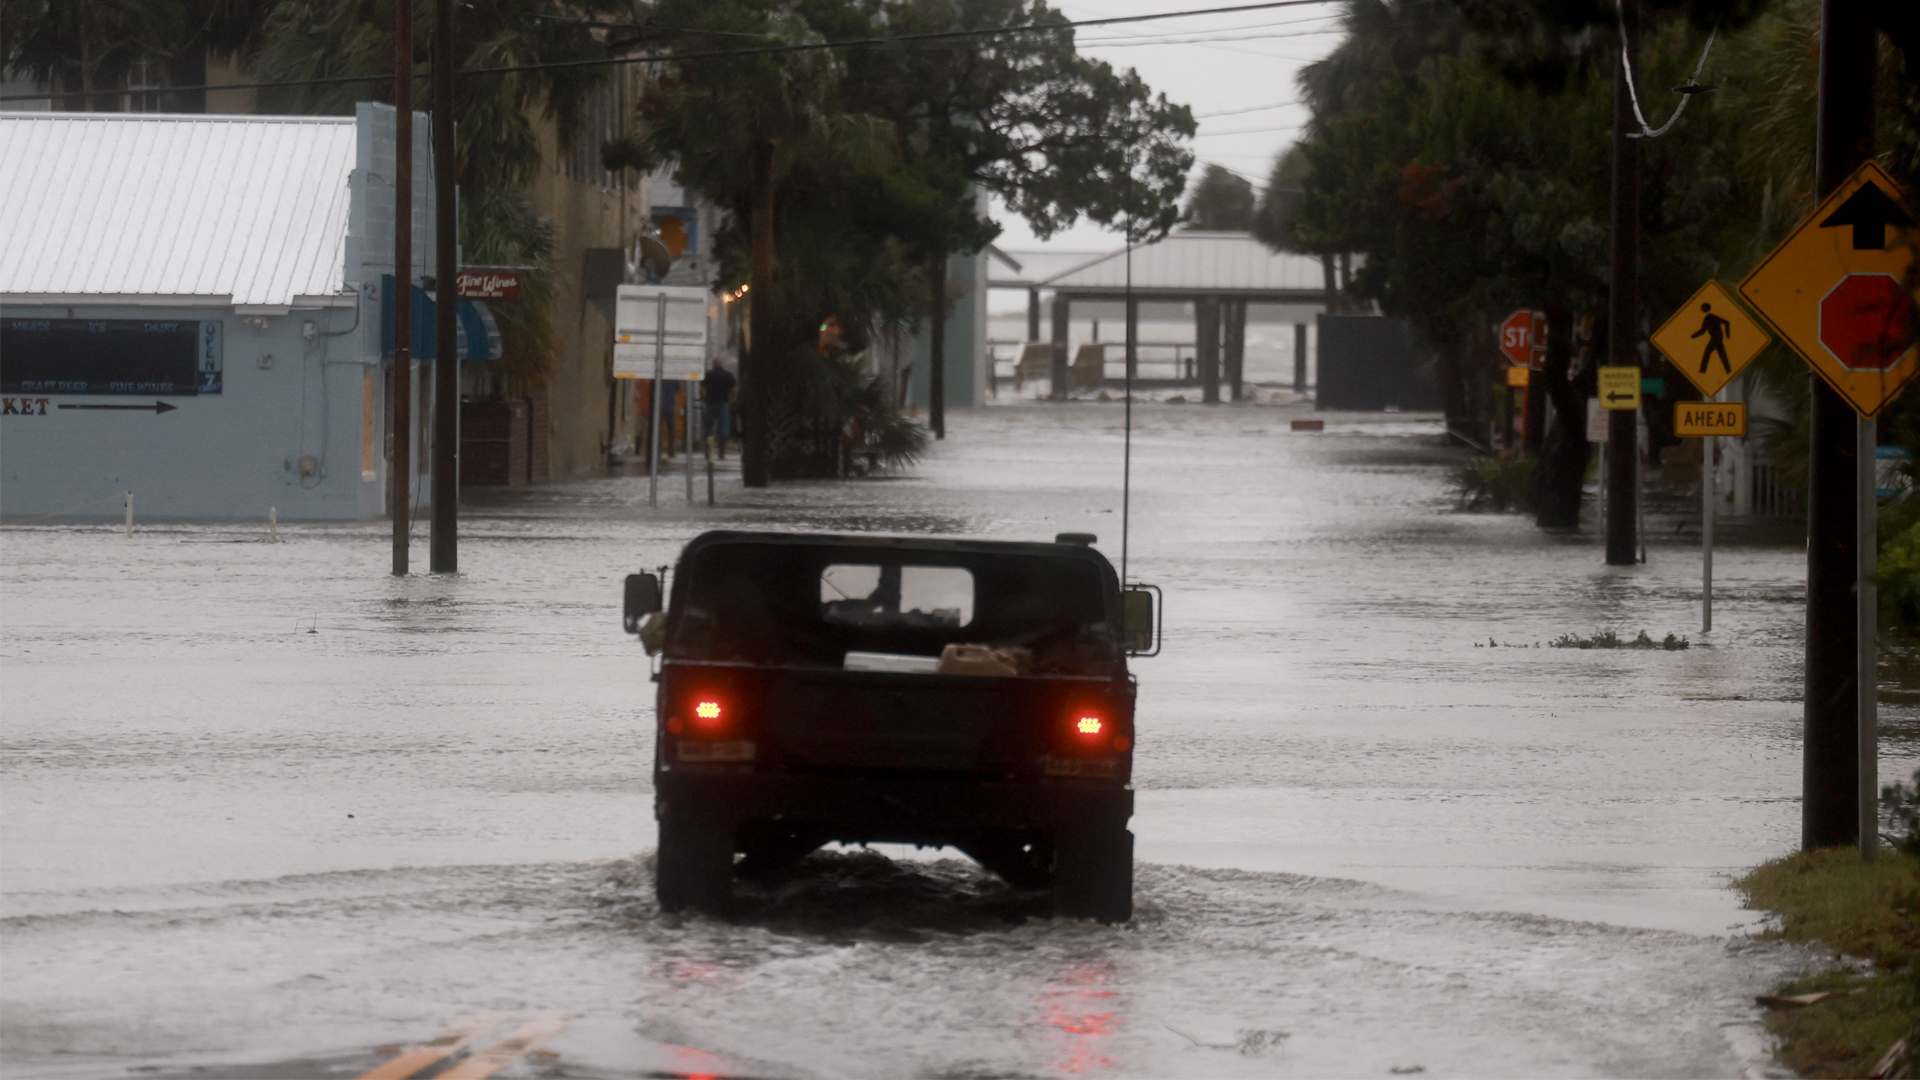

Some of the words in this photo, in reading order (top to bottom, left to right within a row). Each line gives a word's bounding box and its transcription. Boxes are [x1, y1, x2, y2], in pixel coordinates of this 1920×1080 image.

[457, 275, 482, 296] Fine
[483, 275, 518, 292] Wines
[12, 321, 51, 331] MEATS
[89, 322, 107, 332] ICE
[144, 323, 179, 333] DAIRY
[205, 323, 215, 371] OPEN
[21, 381, 56, 391] CRAFT
[205, 373, 215, 387] 7
[110, 382, 135, 392] FINE
[137, 383, 174, 392] WINES
[0, 398, 49, 415] KET
[1684, 411, 1737, 427] AHEAD
